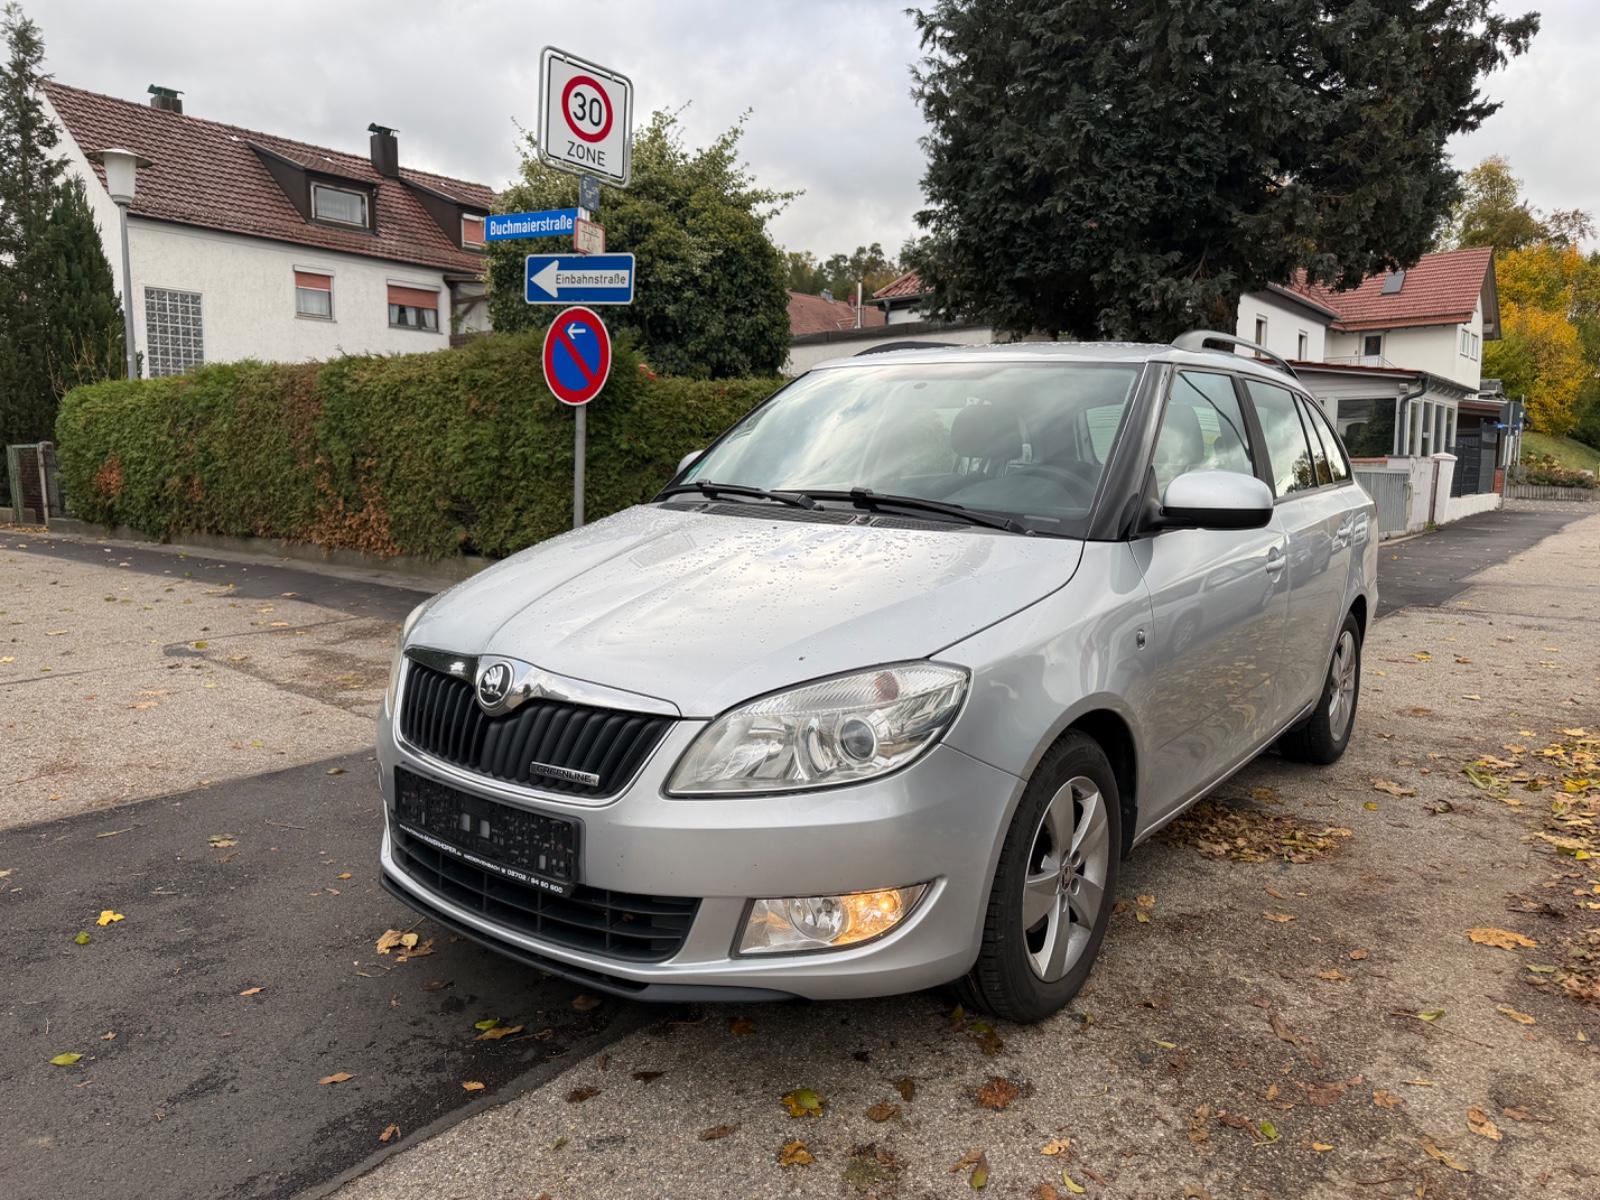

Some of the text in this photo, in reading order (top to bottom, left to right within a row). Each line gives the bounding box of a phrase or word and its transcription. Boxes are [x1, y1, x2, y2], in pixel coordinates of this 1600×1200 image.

[573, 92, 602, 127] 30
[567, 140, 606, 168] ZONE
[490, 214, 573, 236] Buchmaierstraße
[555, 273, 627, 285] Einbahnstraße
[536, 765, 592, 783] GREENLINE
